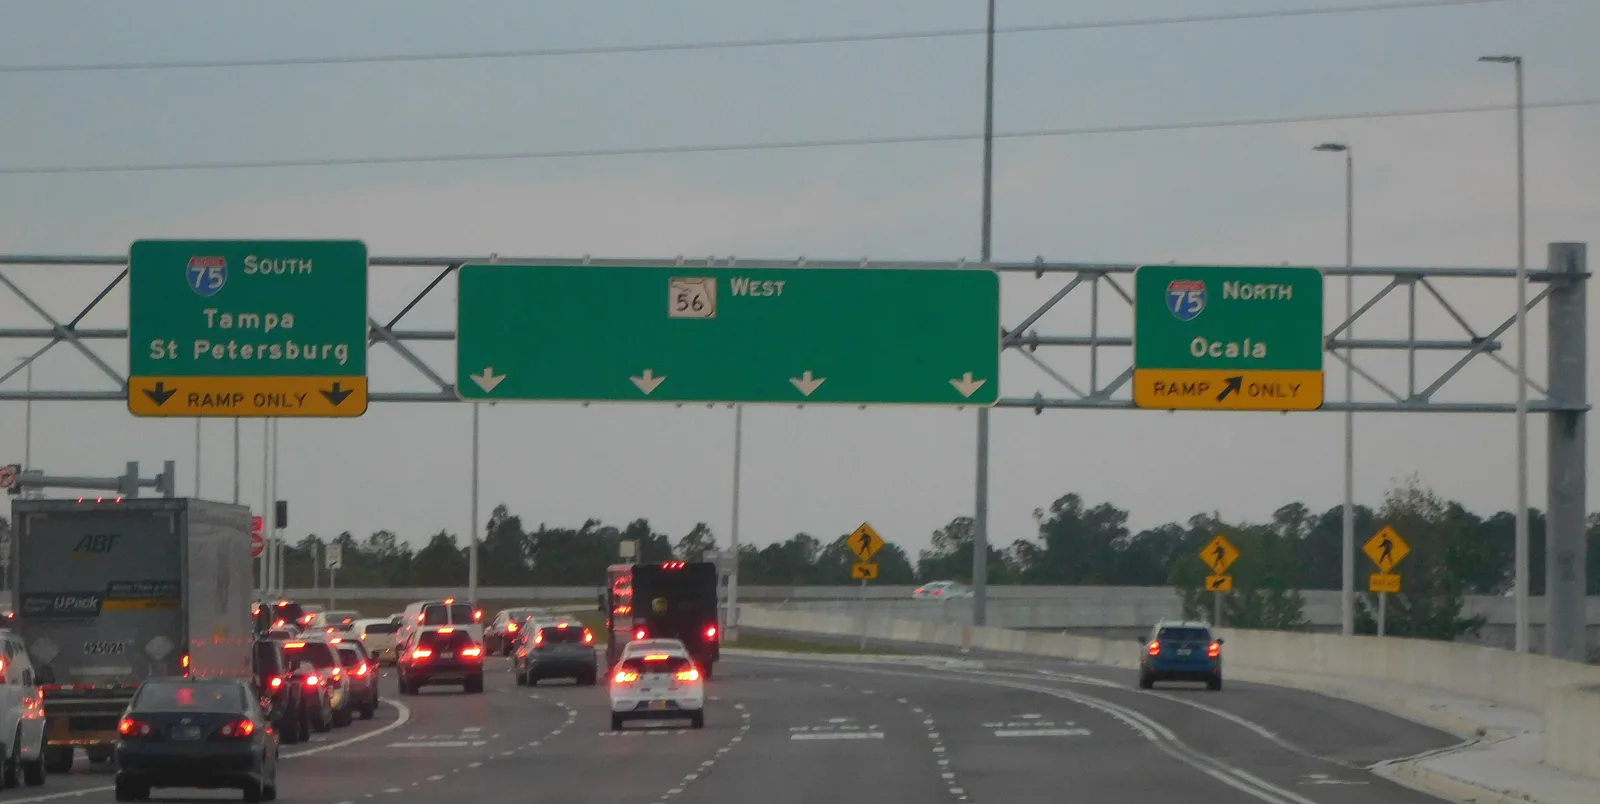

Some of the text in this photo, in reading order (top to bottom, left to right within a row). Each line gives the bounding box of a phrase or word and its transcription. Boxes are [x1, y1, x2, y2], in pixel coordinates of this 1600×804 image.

[189, 254, 313, 290] 75 SOUTH
[676, 276, 786, 312] 56 WEST
[1170, 280, 1293, 313] 75 NORTH
[203, 308, 295, 333] Tampa
[149, 339, 349, 365] St Petersburg
[1190, 336, 1267, 358] Ocala
[187, 392, 307, 407] RAMP ONLY
[1153, 380, 1302, 398] RAMP ONLY
[73, 532, 122, 553] ABF
